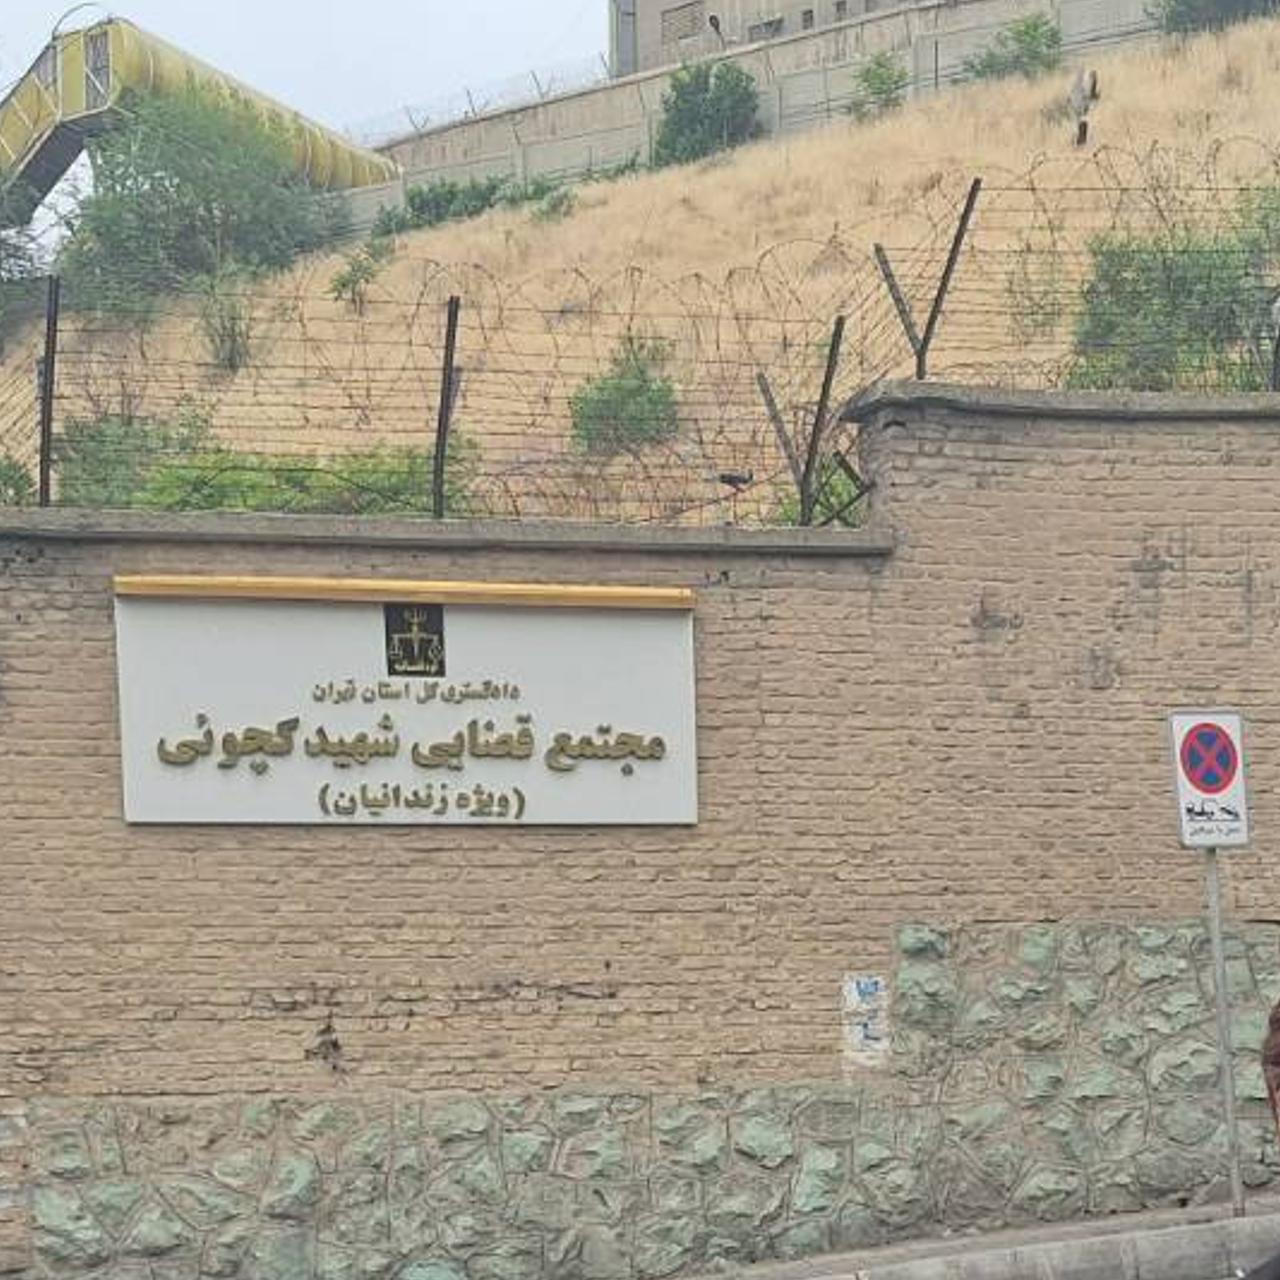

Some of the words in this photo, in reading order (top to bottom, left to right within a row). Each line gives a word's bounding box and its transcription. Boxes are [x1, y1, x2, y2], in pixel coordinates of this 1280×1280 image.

[303, 713, 400, 765] شهید
[411, 713, 535, 772] قضایی
[544, 723, 667, 776] مجتمع
[317, 782, 450, 816] زندانیان)
[456, 784, 526, 820] (ویژه
